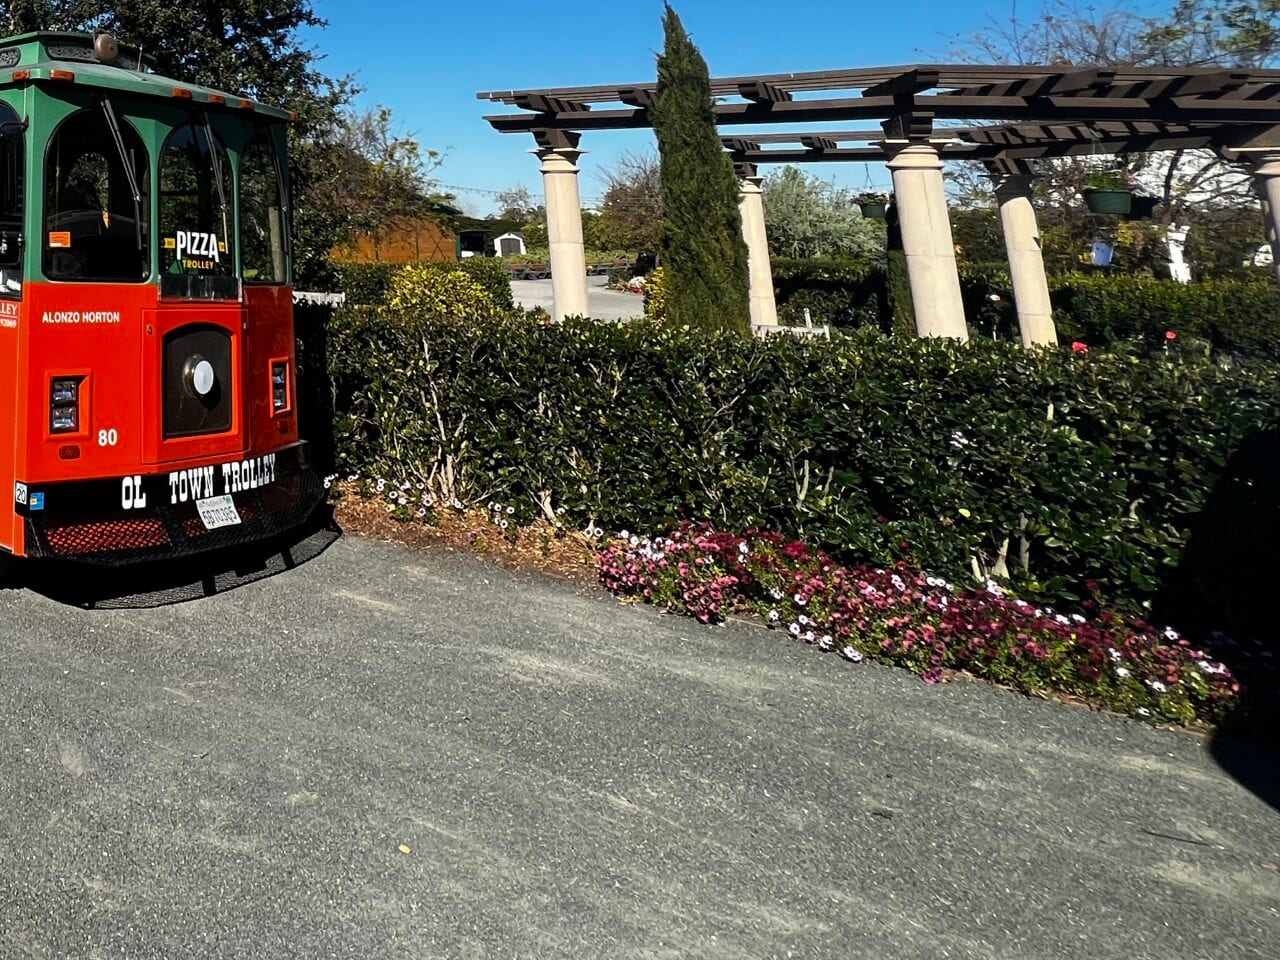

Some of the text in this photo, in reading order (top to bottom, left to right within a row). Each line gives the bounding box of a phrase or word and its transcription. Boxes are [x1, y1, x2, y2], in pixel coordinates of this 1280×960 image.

[176, 230, 219, 263] PIZZA
[182, 259, 215, 269] TROLLEY
[42, 311, 120, 324] ALONZO HORTON
[98, 428, 118, 447] 80
[121, 452, 276, 510] OL TOWN TROLLEY
